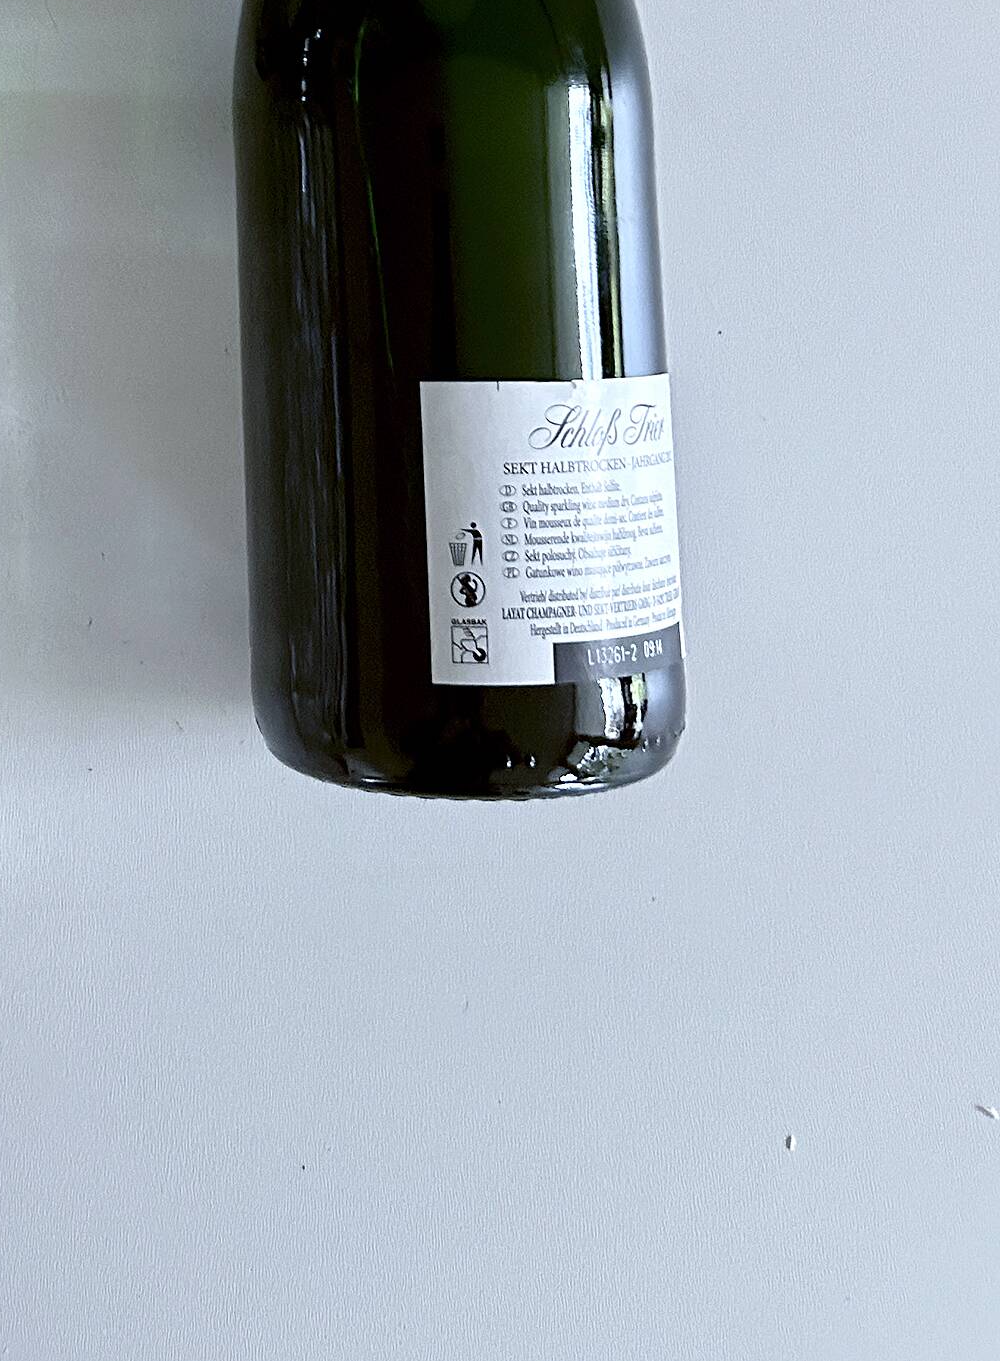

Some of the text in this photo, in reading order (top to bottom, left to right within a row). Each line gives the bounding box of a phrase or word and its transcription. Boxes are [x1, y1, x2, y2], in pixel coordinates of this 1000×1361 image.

[528, 404, 621, 456] Schloß
[503, 460, 537, 475] SEKT
[541, 456, 627, 474] HALBTROCKEN
[522, 483, 537, 496] Sekt
[523, 499, 549, 516] Quality
[523, 517, 537, 529] Vin
[525, 549, 540, 562] Sekt
[502, 607, 525, 620] LAYAT
